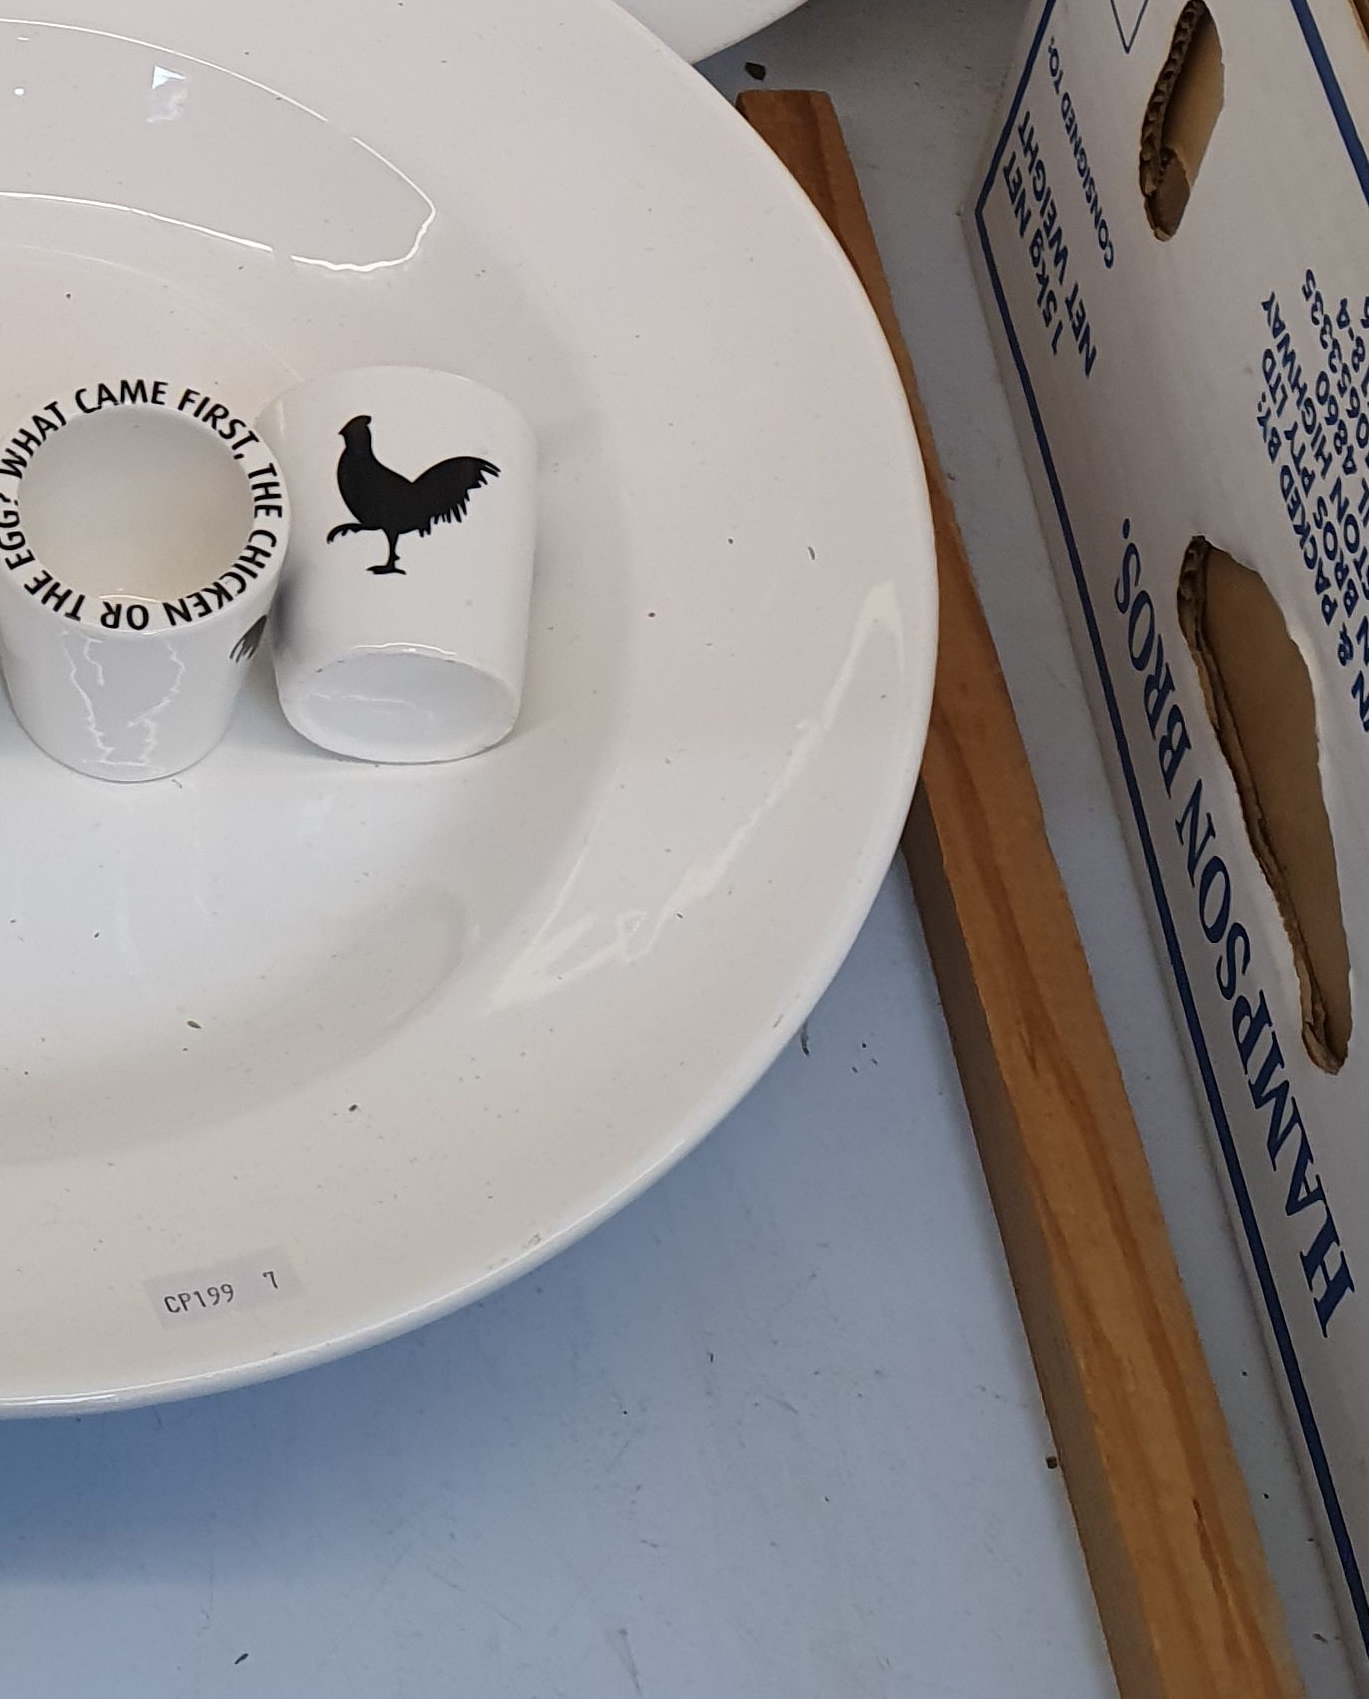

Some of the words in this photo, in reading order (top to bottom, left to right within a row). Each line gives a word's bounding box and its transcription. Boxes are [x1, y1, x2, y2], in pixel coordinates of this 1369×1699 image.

[1003, 151, 1032, 239] NET
[1018, 111, 1069, 286] WEIGHT
[1061, 92, 1115, 269] CONSIGNED
[1065, 281, 1097, 378] NET
[74, 379, 168, 414] CAME
[177, 388, 260, 460] FIRST,
[1256, 391, 1282, 464] BY:
[1261, 291, 1333, 480] HIGHWAY
[1262, 349, 1289, 418] LTD
[1316, 371, 1357, 475] 4860
[247, 462, 283, 519] THE
[1284, 421, 1316, 498] PTY
[163, 529, 277, 627] CHICKEN
[1280, 465, 1338, 626] PACKED
[1312, 496, 1359, 618] BROS
[23, 569, 85, 622] THE
[100, 601, 149, 630] OR
[1114, 518, 1192, 799] BROS.
[1176, 778, 1356, 1338] HAMPSON
[164, 1283, 234, 1313] CP199
[262, 1271, 278, 1289] 7
